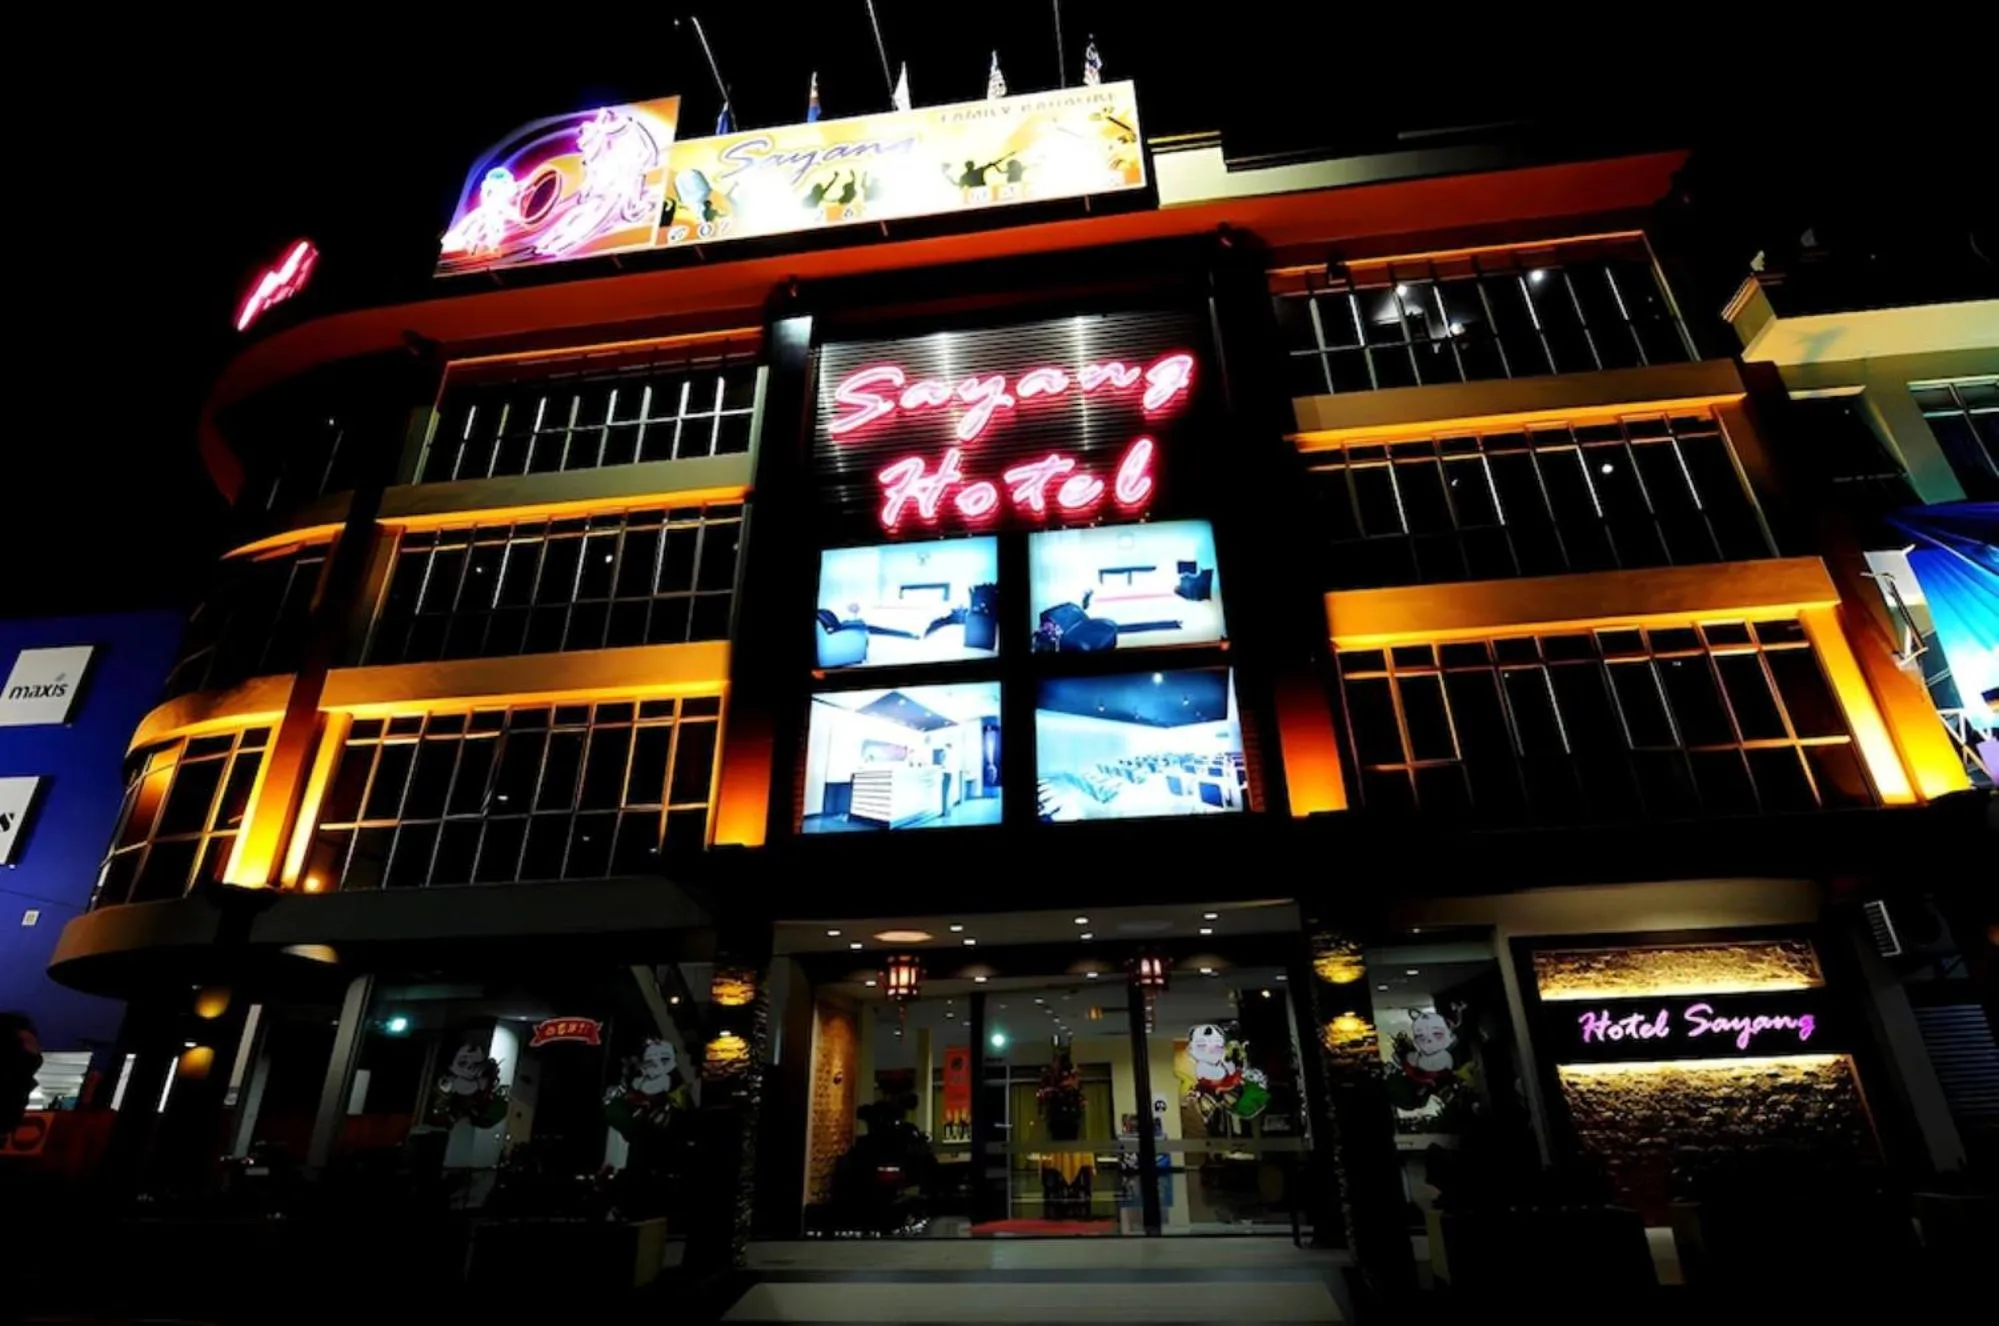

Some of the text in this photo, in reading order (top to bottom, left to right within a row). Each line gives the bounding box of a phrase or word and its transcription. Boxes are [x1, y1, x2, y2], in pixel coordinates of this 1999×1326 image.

[828, 353, 1195, 442] Sayang
[878, 437, 1154, 527] Hotel
[8, 677, 69, 700] maxis
[1578, 1002, 1816, 1050] Hotel Sayang
